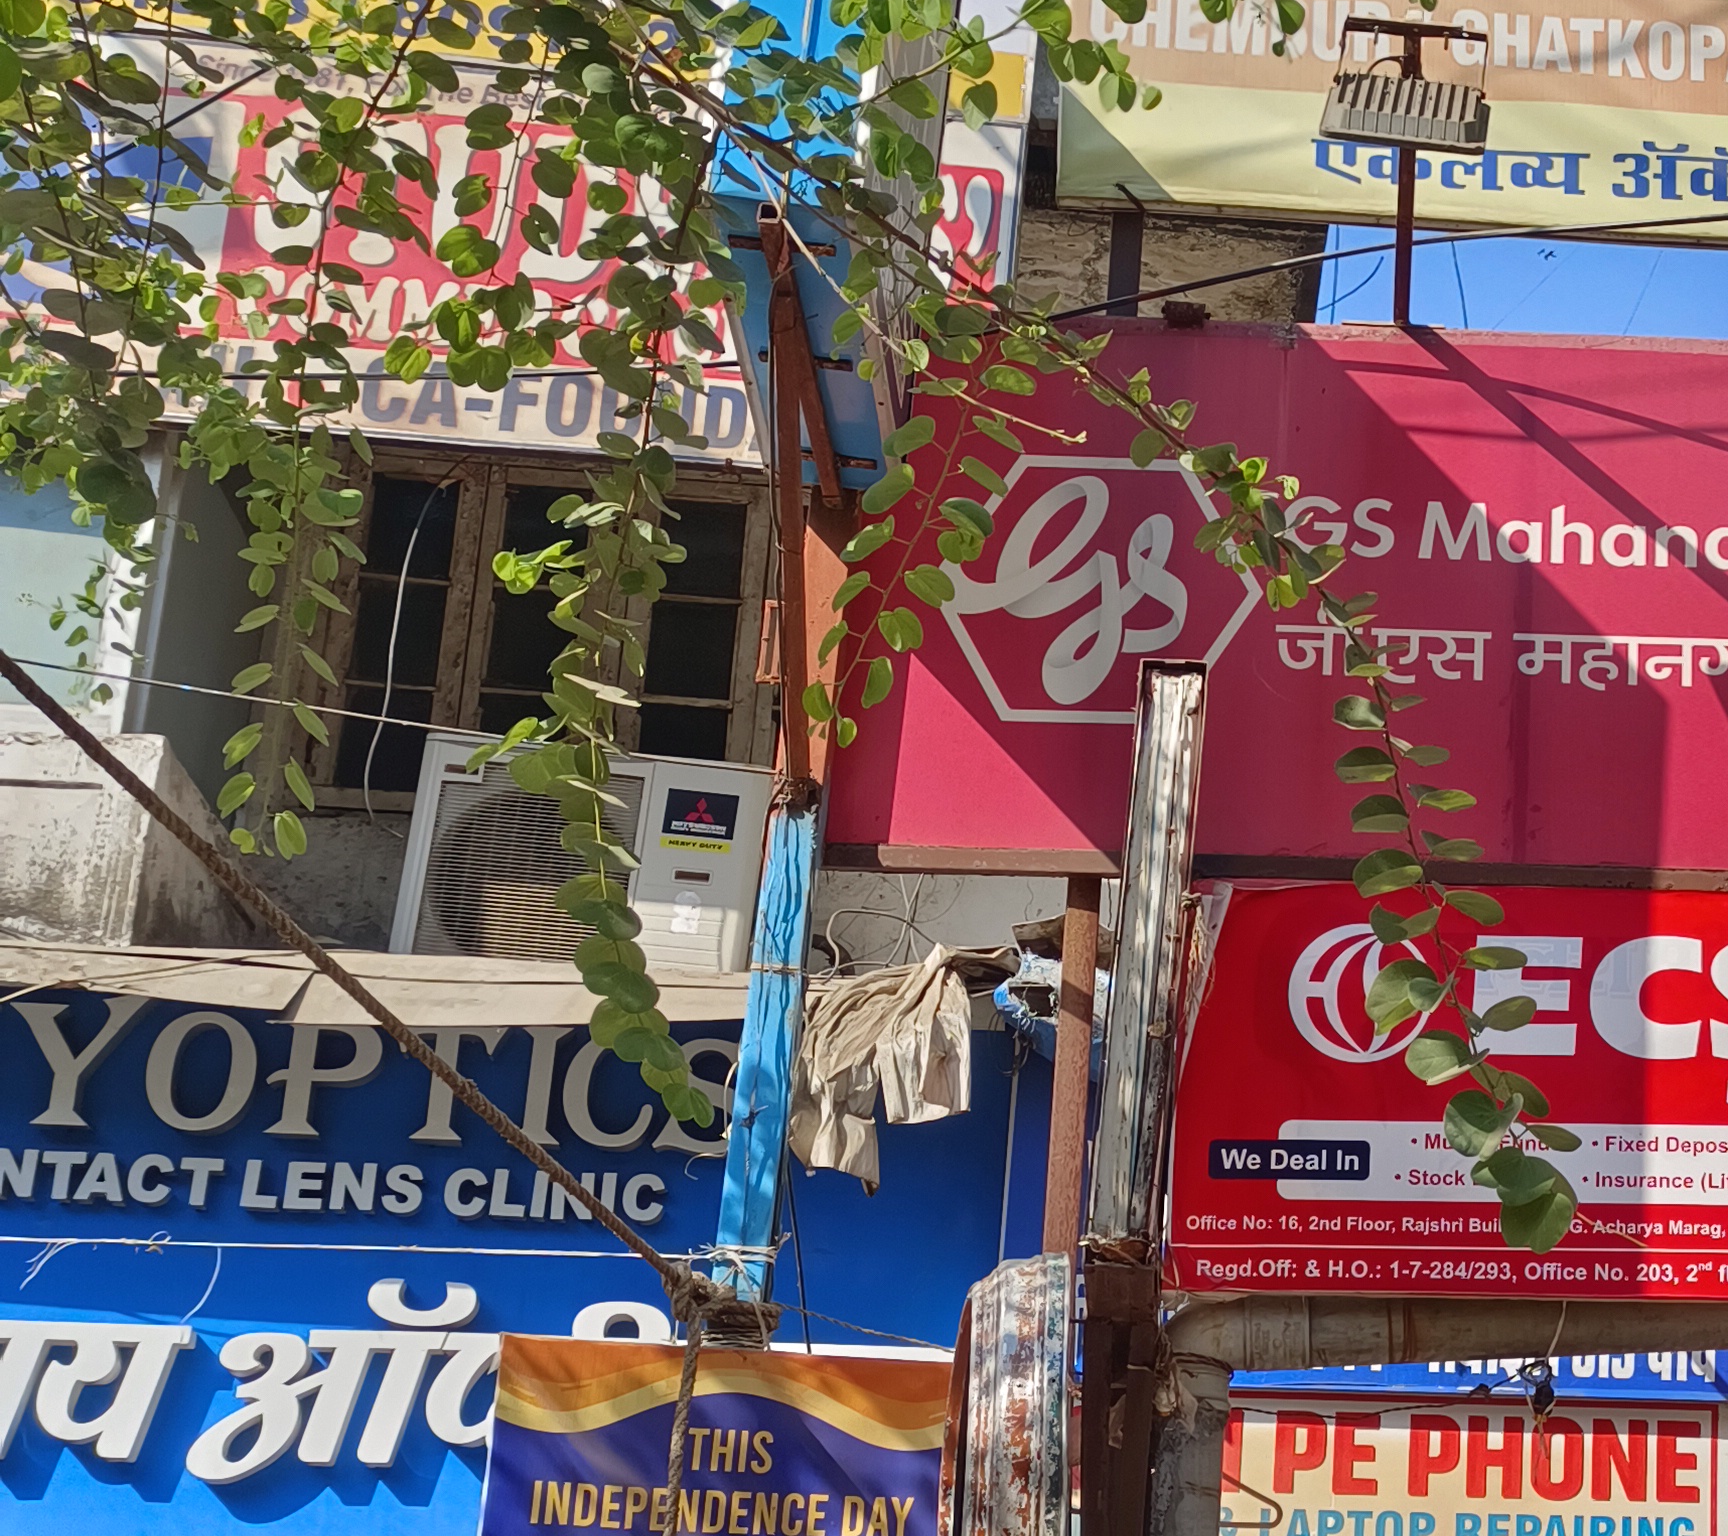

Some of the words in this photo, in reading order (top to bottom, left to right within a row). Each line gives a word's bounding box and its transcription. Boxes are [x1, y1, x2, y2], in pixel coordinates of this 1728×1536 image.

[1605, 1136, 1659, 1153] Fixed
[1221, 1149, 1261, 1170] We
[1271, 1149, 1327, 1170] Deal
[1337, 1150, 1360, 1171] In
[1408, 1169, 1465, 1186] Stock
[1595, 1172, 1694, 1189] Insurance
[239, 1159, 424, 1215] LENS
[444, 1168, 666, 1222] CLINIC
[1524, 1262, 1587, 1281] Office
[687, 1427, 774, 1475] THIS
[1272, 1410, 1381, 1496] PE
[1408, 1413, 1701, 1503] PHONE
